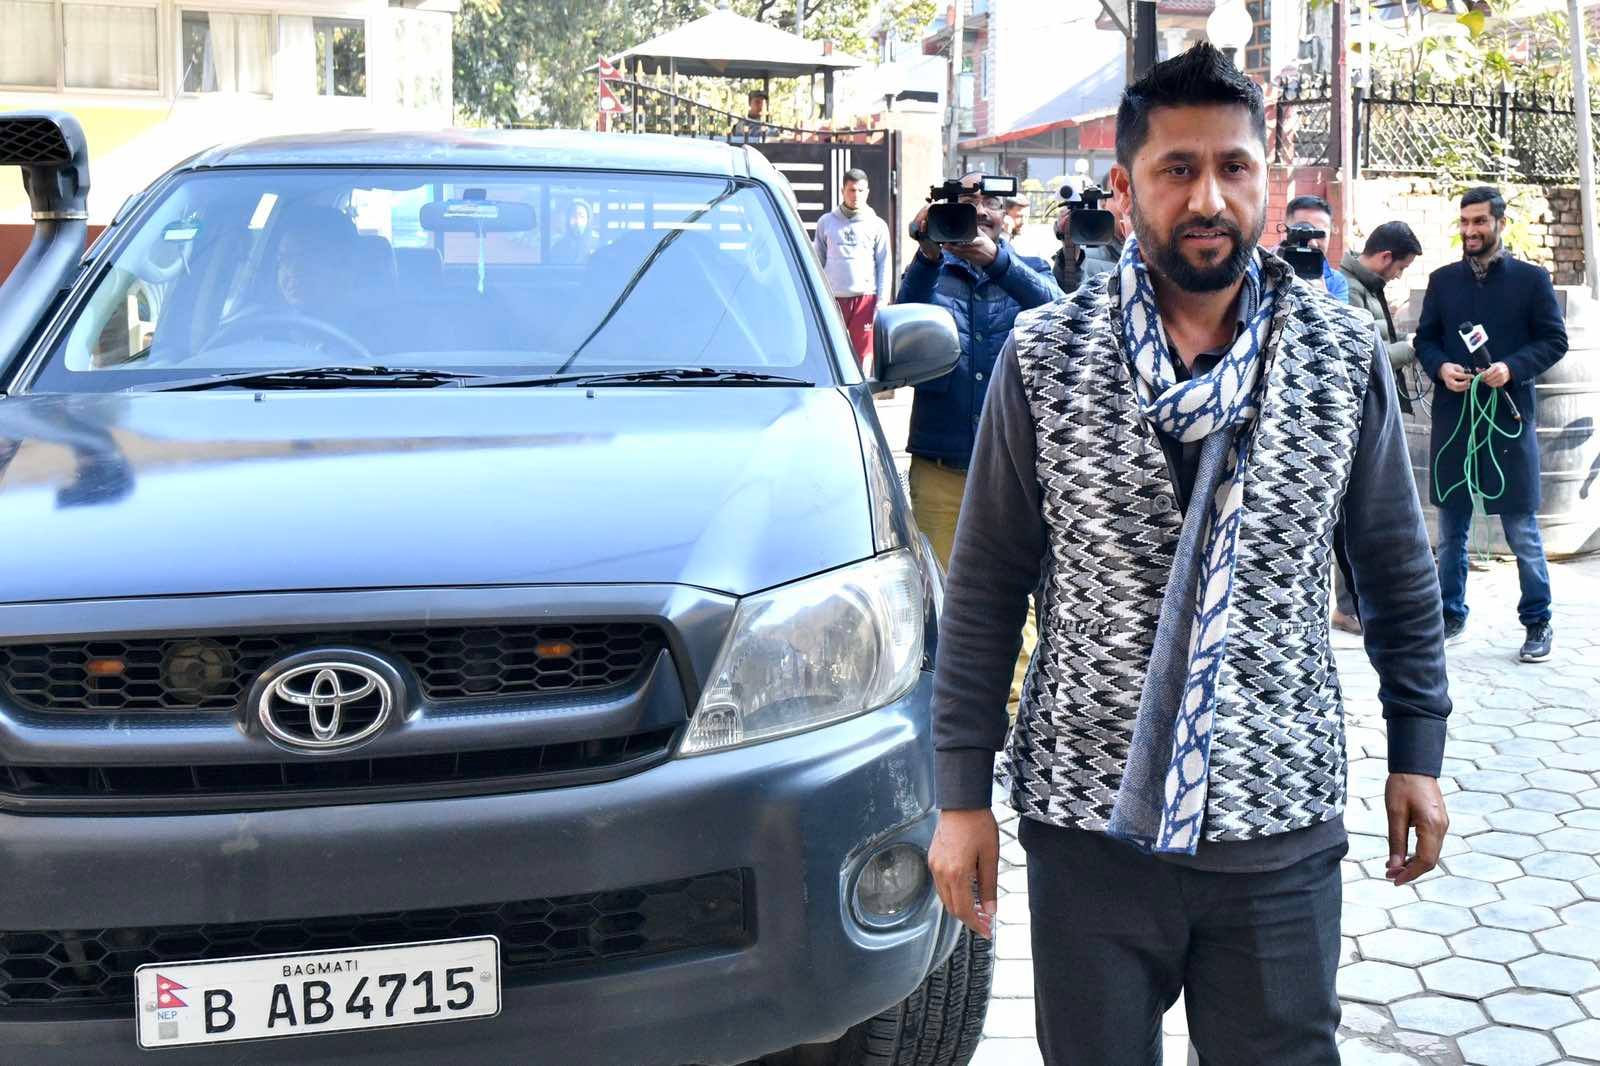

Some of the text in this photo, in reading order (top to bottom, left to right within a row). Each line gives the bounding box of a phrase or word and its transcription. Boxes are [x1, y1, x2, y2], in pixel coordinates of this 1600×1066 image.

[282, 959, 359, 977] BAGMATI
[157, 1010, 178, 1021] NEP
[204, 989, 236, 1034] B
